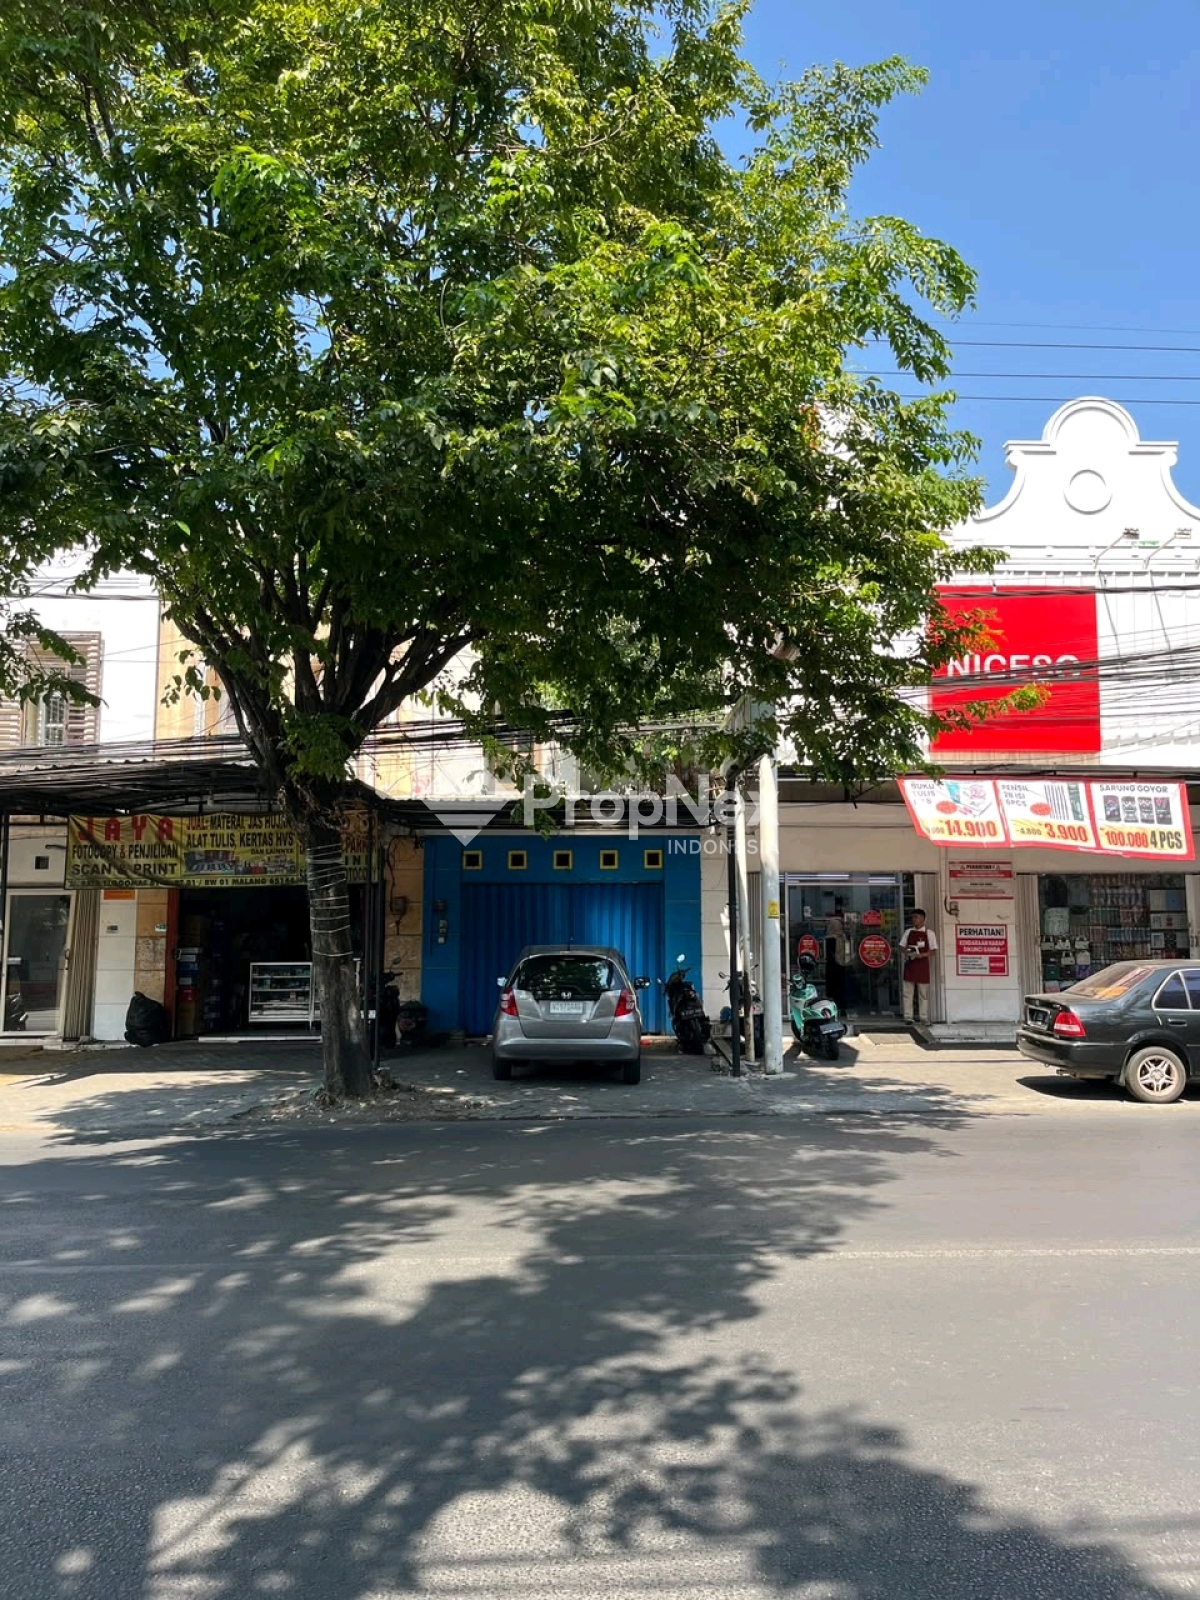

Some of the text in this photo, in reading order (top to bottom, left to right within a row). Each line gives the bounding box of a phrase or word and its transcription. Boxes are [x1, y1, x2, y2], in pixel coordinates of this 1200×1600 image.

[79, 815, 173, 841] JAYA
[248, 815, 262, 829] JAS
[945, 820, 998, 837] 14.900
[186, 831, 294, 849] ALAT TULIS, KERTAS HVS
[1044, 823, 1089, 842] 3.900
[1105, 830, 1183, 849] 100.000 4 PCS
[72, 845, 116, 859] FOTOCOPY
[128, 844, 178, 859] PENJILIDAN
[72, 864, 112, 876] SCAN
[133, 863, 177, 876] PRINT
